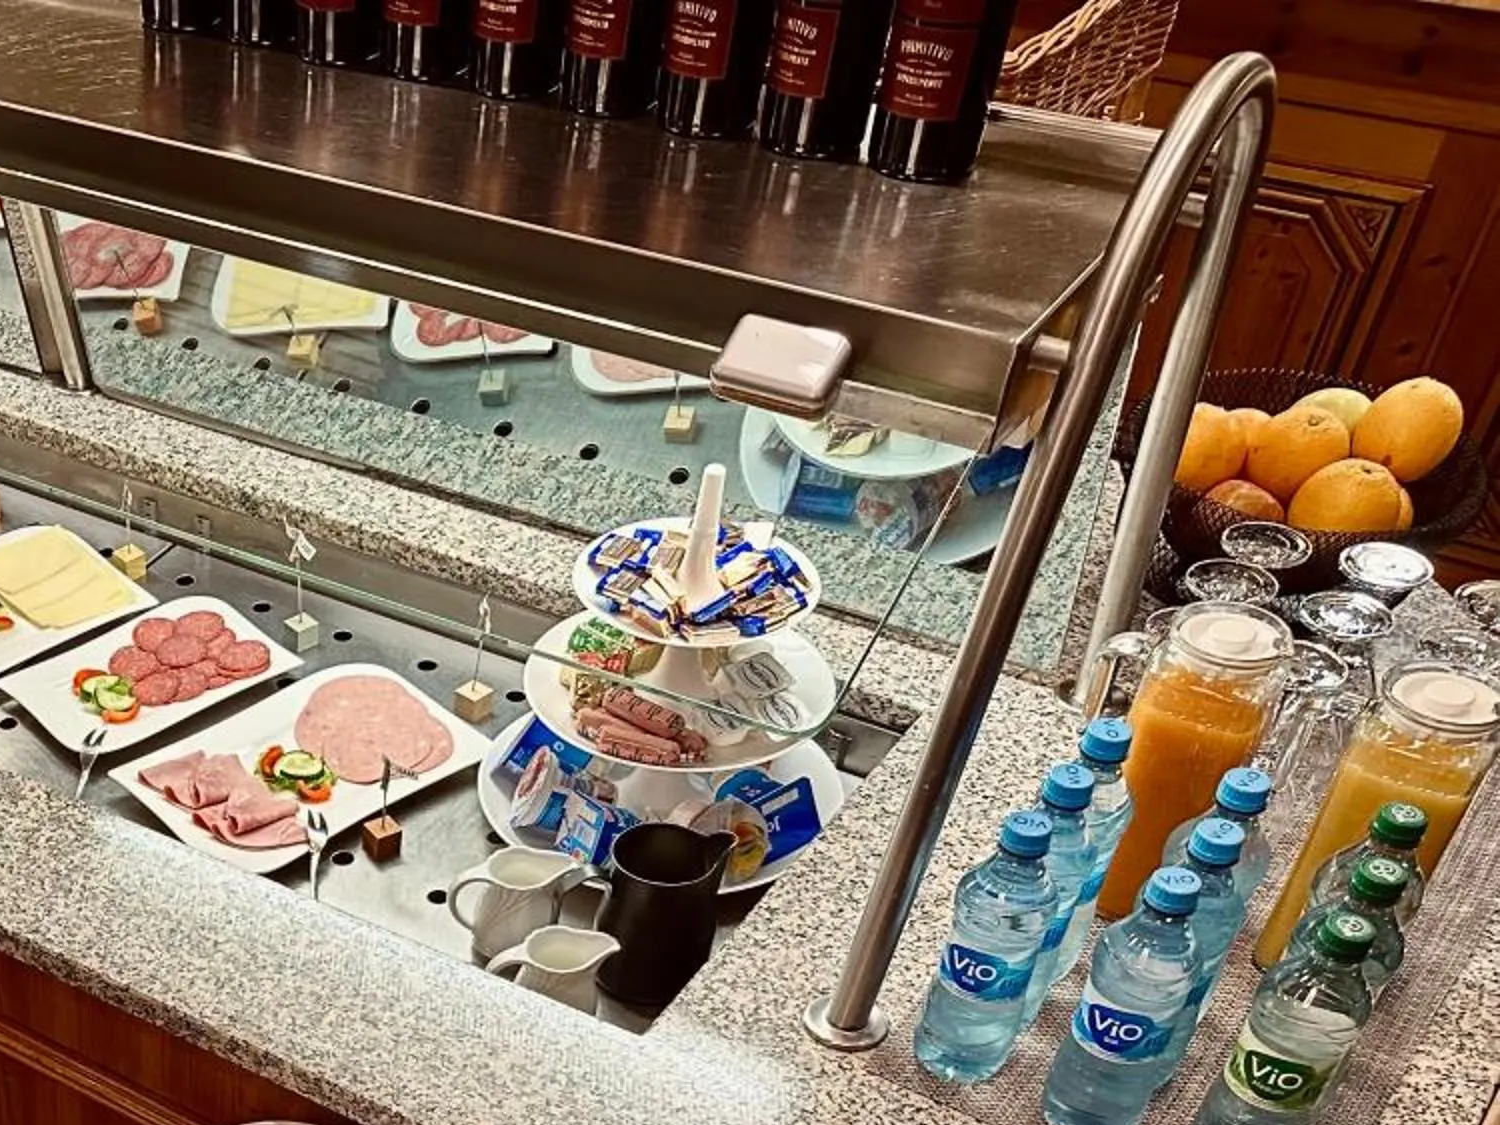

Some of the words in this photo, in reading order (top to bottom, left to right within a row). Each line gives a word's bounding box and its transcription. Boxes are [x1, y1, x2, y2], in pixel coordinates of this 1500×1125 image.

[953, 948, 997, 981] ViO
[1094, 1008, 1143, 1041] ViO
[1251, 1055, 1303, 1090] ViO
